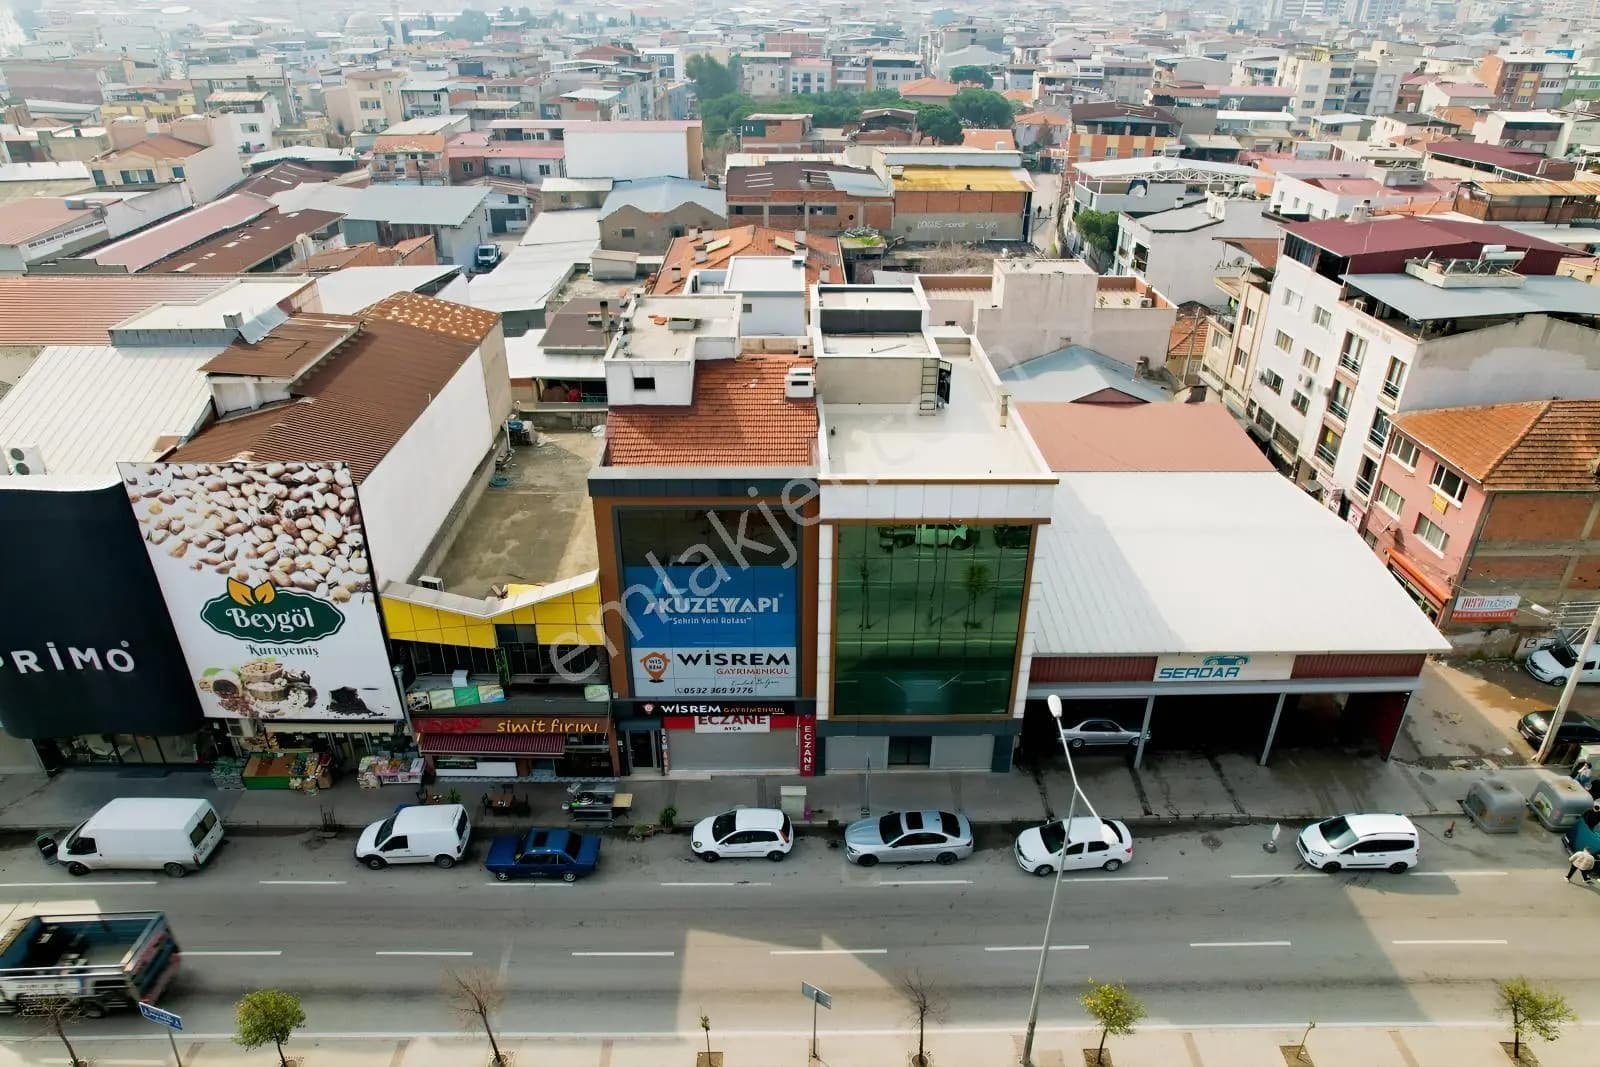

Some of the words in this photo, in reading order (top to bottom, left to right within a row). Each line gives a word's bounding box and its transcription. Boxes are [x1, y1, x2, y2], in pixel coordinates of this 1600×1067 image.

[225, 607, 315, 633] Beygöl
[0, 641, 135, 674] RİMO
[245, 644, 320, 658] Kuruyemiş
[677, 650, 790, 666] WİSREM
[1159, 667, 1241, 679] SERDAR
[661, 703, 722, 714] WİSREM
[497, 719, 545, 733] simit
[699, 715, 767, 725] ECZANE
[803, 725, 812, 772] ECZANE
